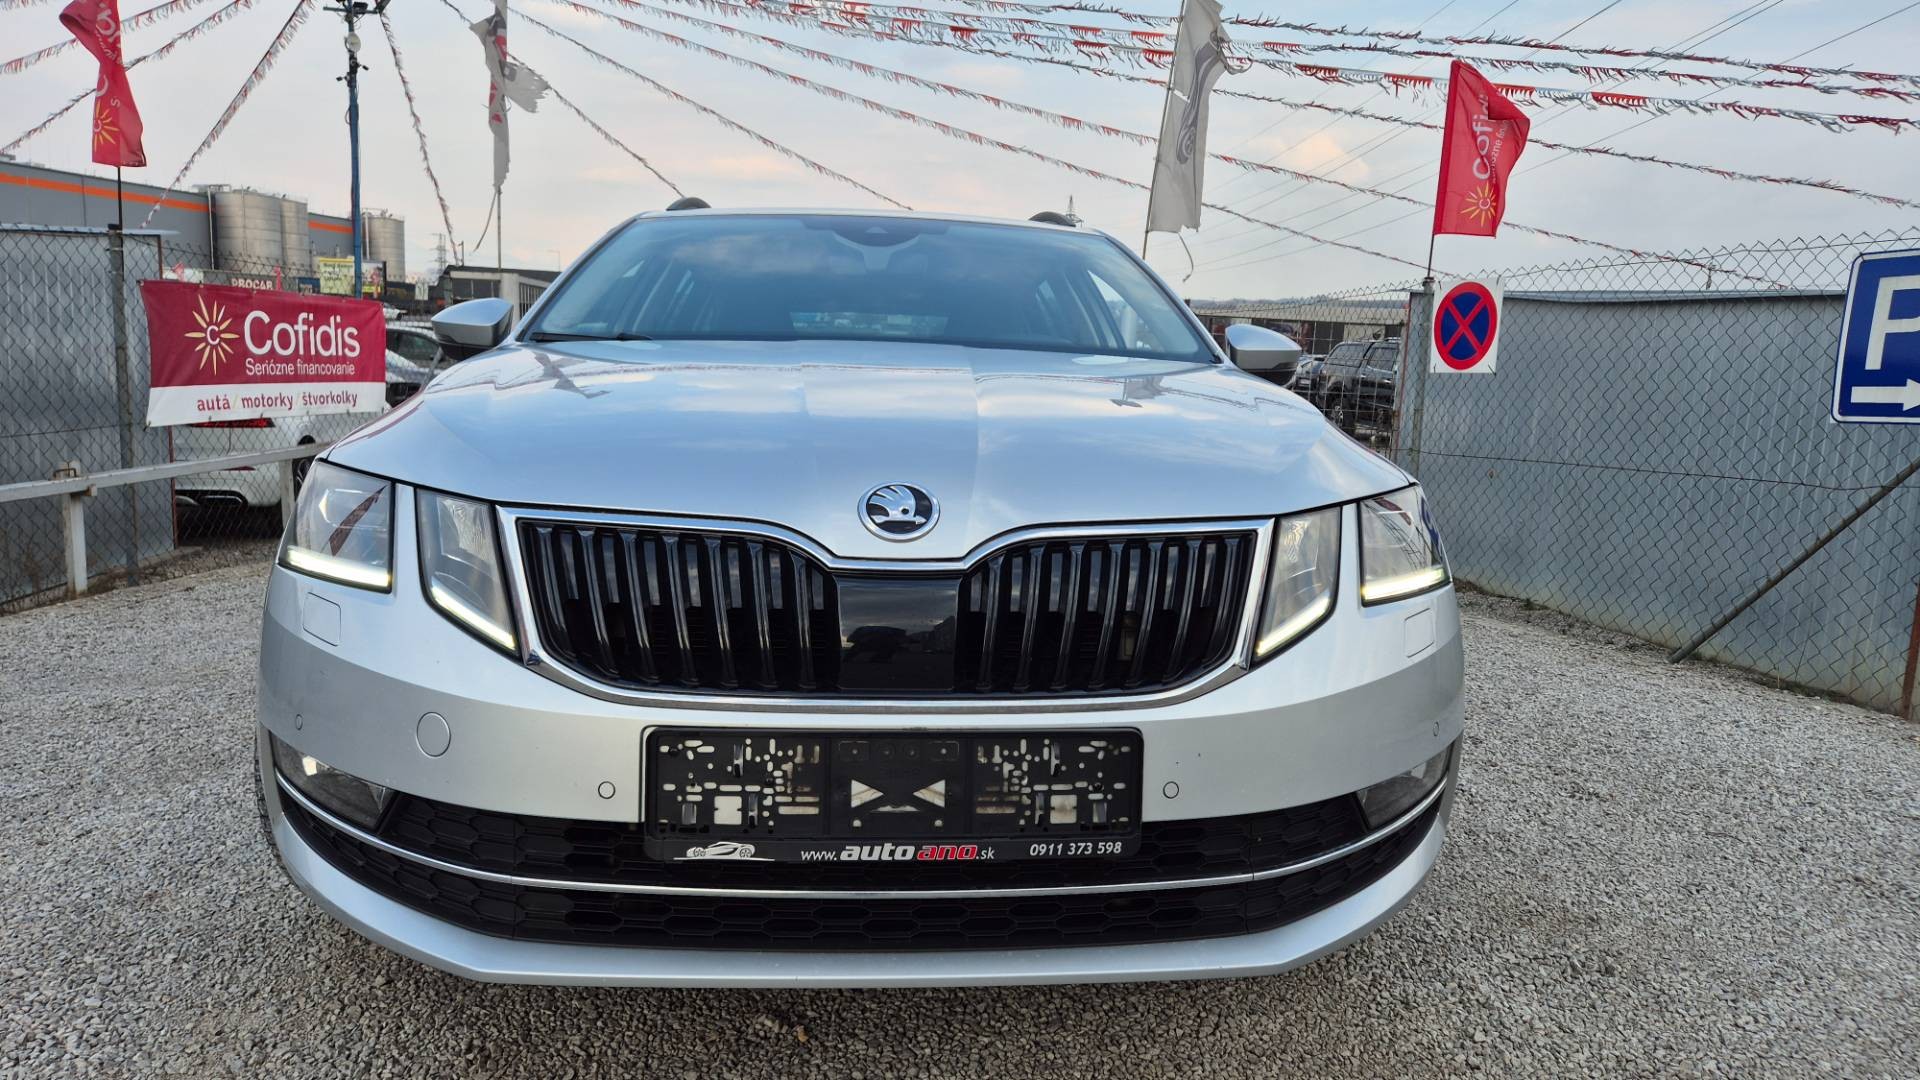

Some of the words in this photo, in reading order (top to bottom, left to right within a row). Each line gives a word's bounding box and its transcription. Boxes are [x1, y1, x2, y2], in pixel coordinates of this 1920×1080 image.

[244, 310, 361, 358] Cofidis
[245, 357, 295, 376] Seriózne
[297, 358, 356, 376] financovanie
[197, 394, 231, 411] autá
[241, 392, 293, 411] motorky
[302, 390, 358, 407] štvorkolky
[1029, 843, 1063, 857] 0911
[1067, 842, 1093, 855] 373
[1097, 841, 1122, 854] 598
